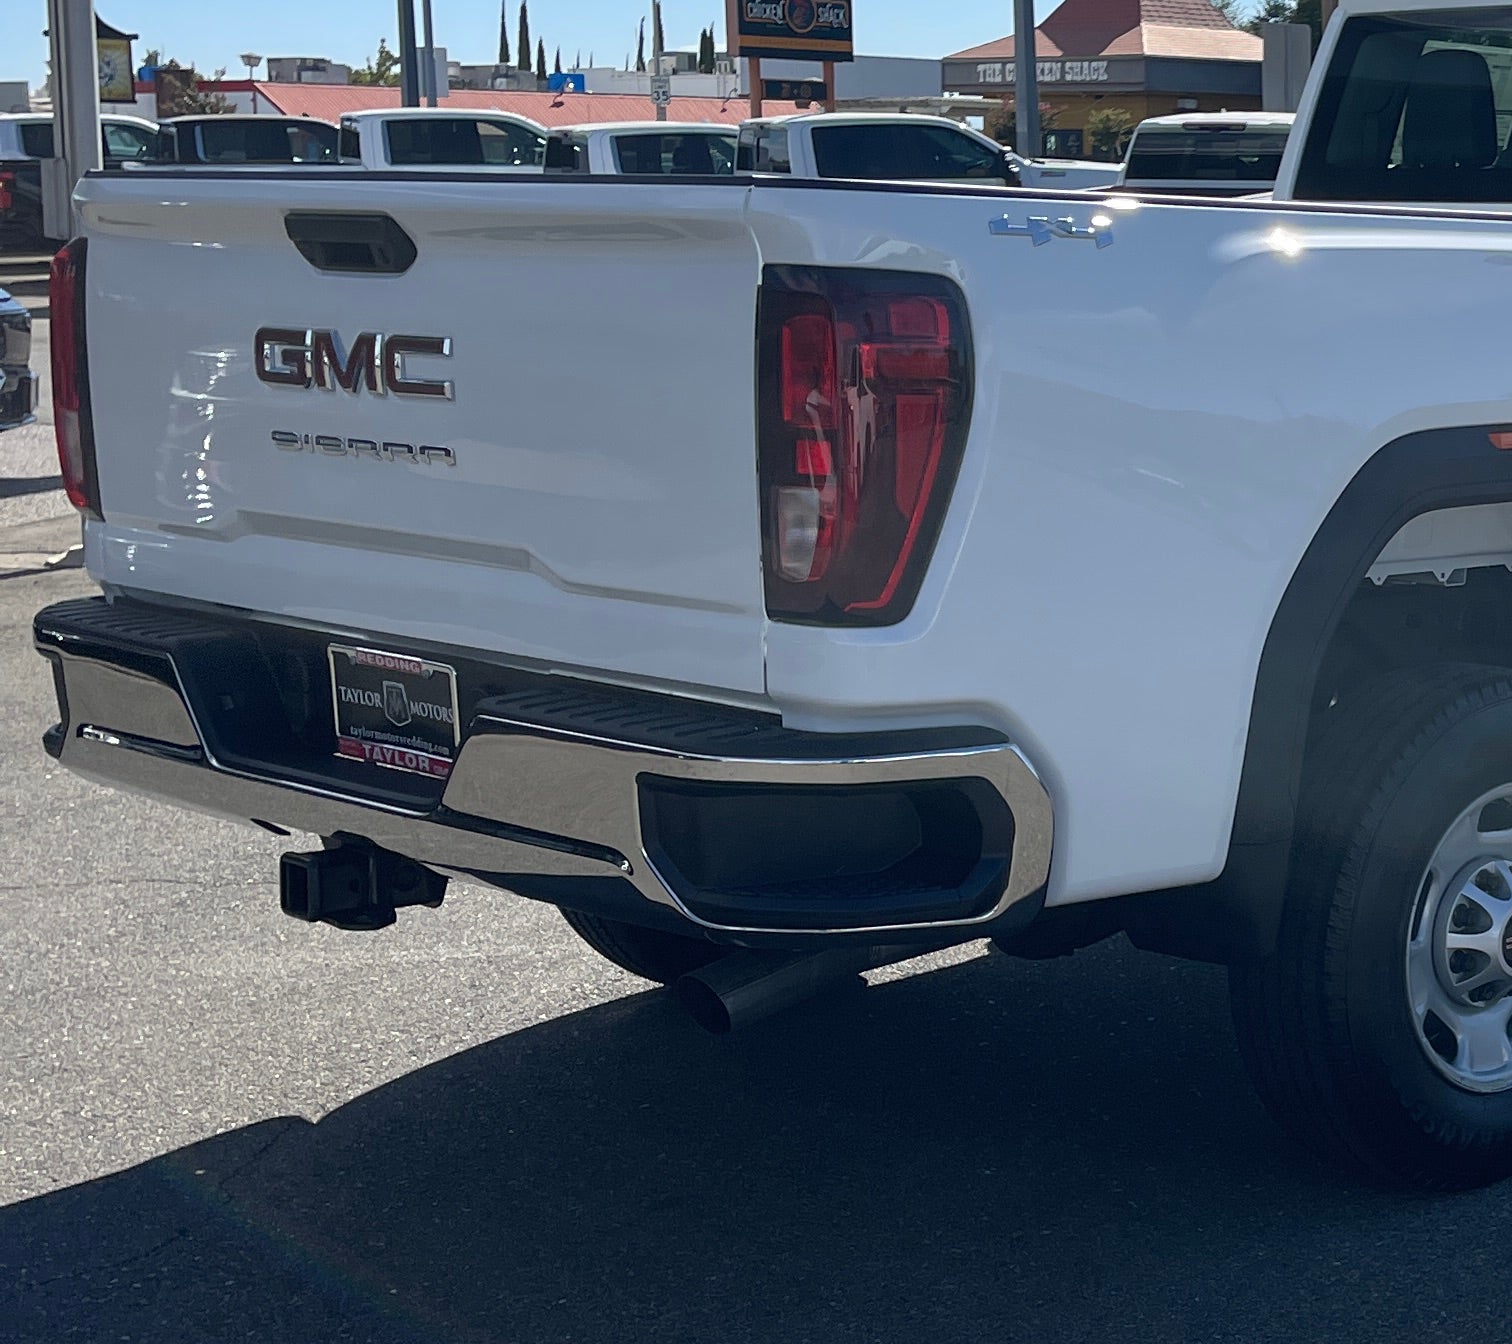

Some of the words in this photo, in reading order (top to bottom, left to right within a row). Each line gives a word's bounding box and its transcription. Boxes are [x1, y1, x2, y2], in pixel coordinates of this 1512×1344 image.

[818, 3, 848, 28] SHACK
[977, 62, 1002, 83] THE
[1005, 61, 1061, 83] CKEN
[1064, 60, 1108, 81] SHACK
[652, 90, 669, 102] 35
[254, 326, 456, 402] GMC
[270, 429, 457, 467] SIERRA
[356, 652, 421, 673] REDDING
[338, 685, 384, 709] TAYLOR
[409, 700, 455, 725] MOTORS
[361, 743, 430, 771] TAYLOR
